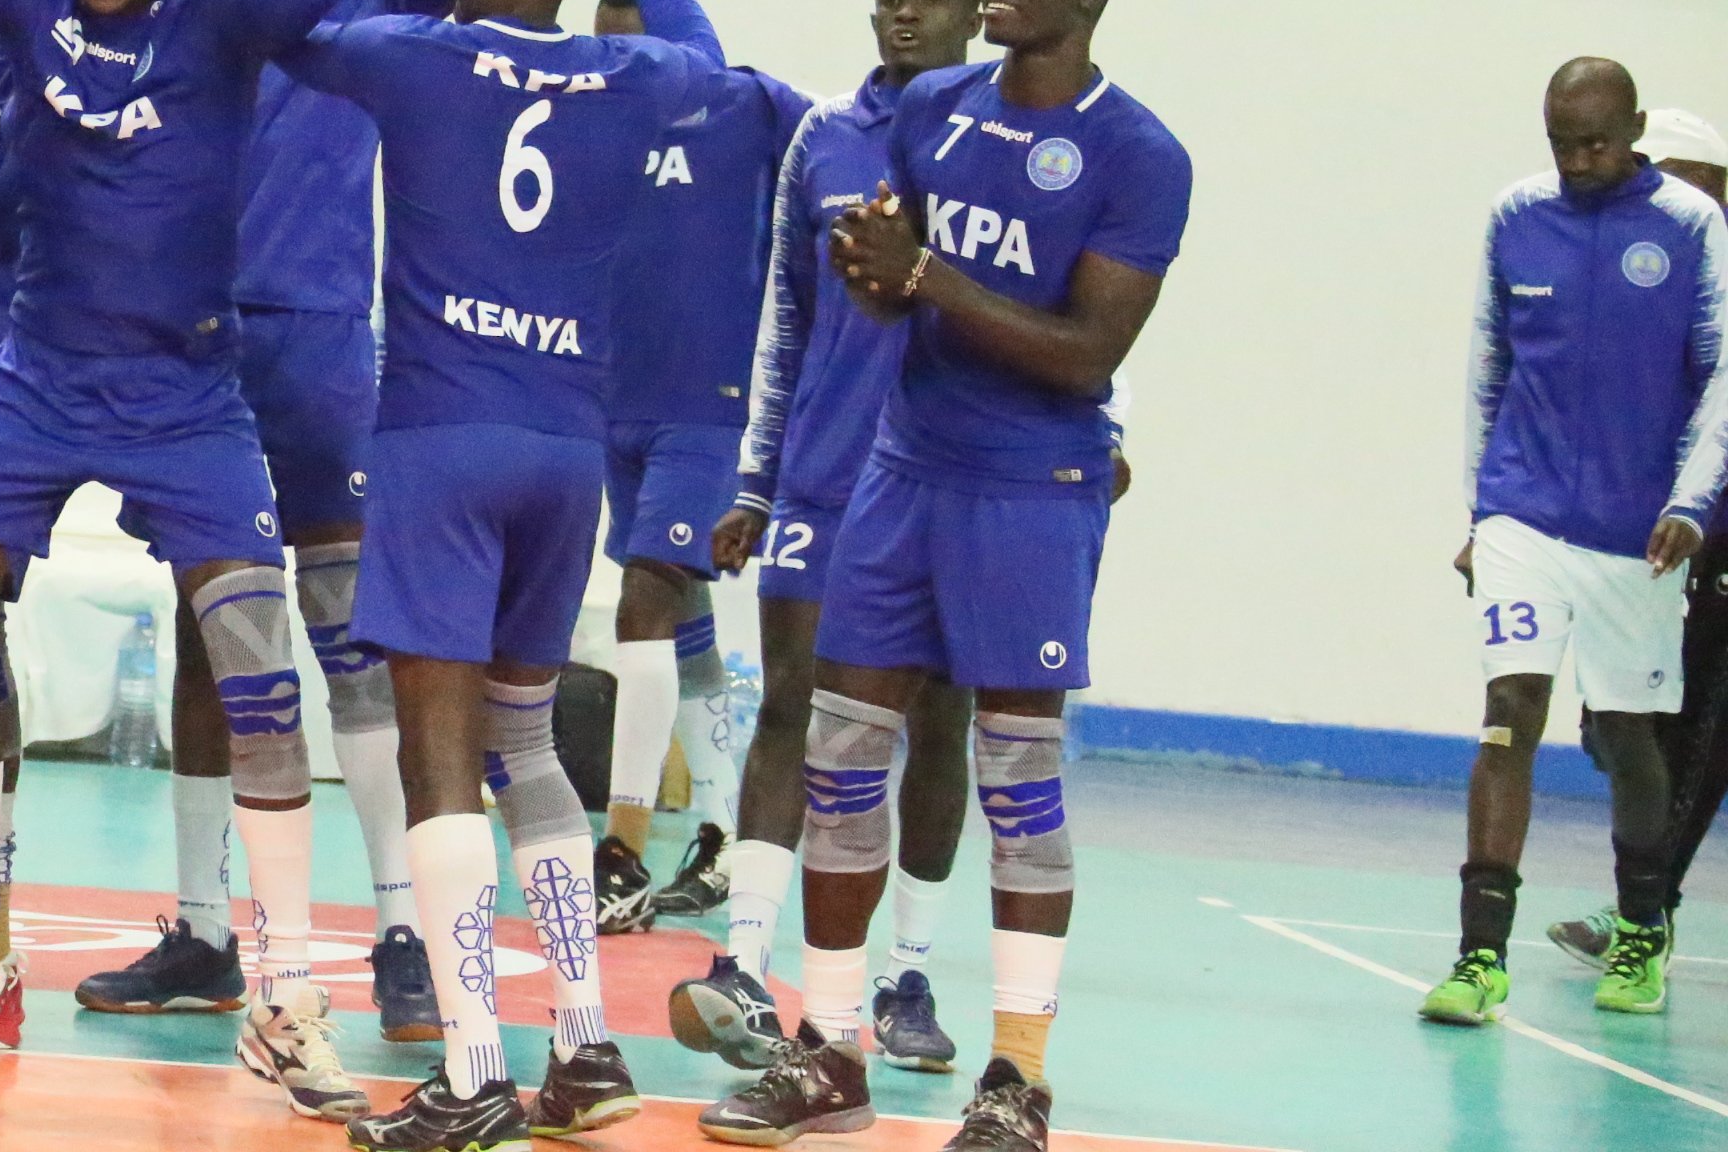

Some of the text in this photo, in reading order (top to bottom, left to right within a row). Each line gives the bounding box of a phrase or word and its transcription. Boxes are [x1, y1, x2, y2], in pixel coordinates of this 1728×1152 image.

[472, 51, 607, 94] KPA
[934, 114, 974, 161] 7
[981, 121, 1034, 144] uhlsport
[499, 99, 554, 233] 6
[927, 193, 1035, 276] KPA
[444, 295, 582, 355] KENYA
[761, 520, 813, 570] 12
[1483, 601, 1539, 646] 13
